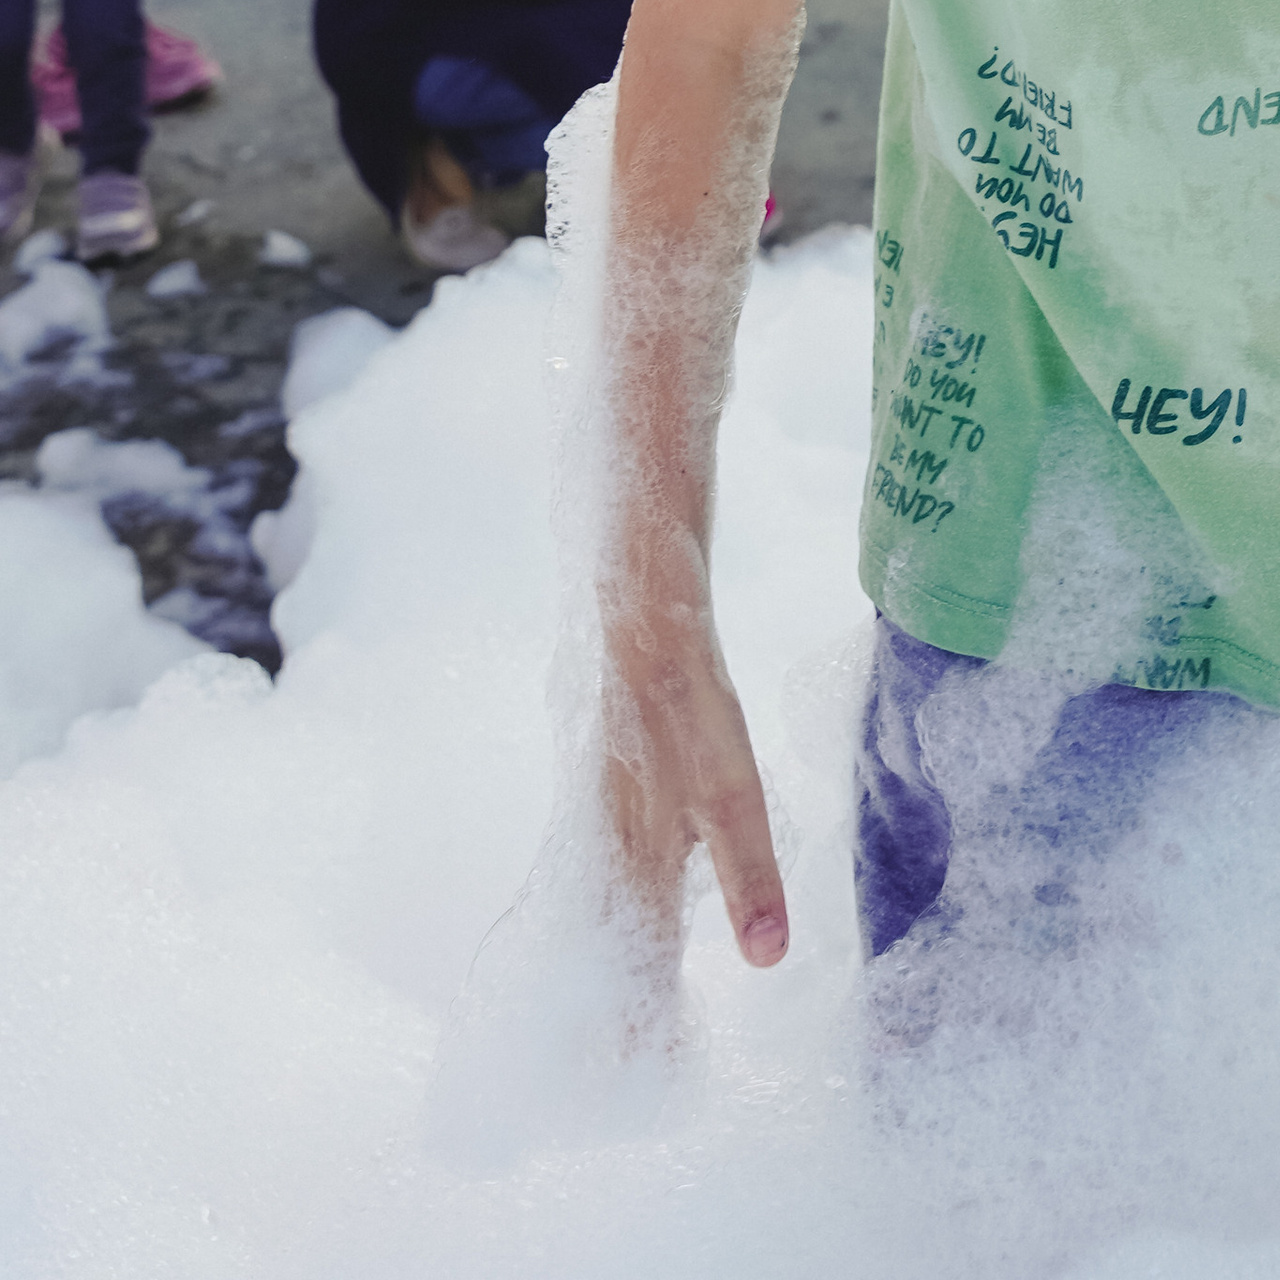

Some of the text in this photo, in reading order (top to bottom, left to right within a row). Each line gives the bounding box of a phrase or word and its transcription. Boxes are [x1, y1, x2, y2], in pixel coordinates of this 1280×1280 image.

[1035, 121, 1060, 156] BE
[957, 127, 1084, 203] WANT TO
[975, 172, 1074, 225] DO YOU
[990, 210, 1064, 269] HEY
[929, 368, 977, 409] YOU
[1111, 377, 1248, 447] HEY!
[950, 414, 985, 453] TO
[903, 448, 949, 486] MY
